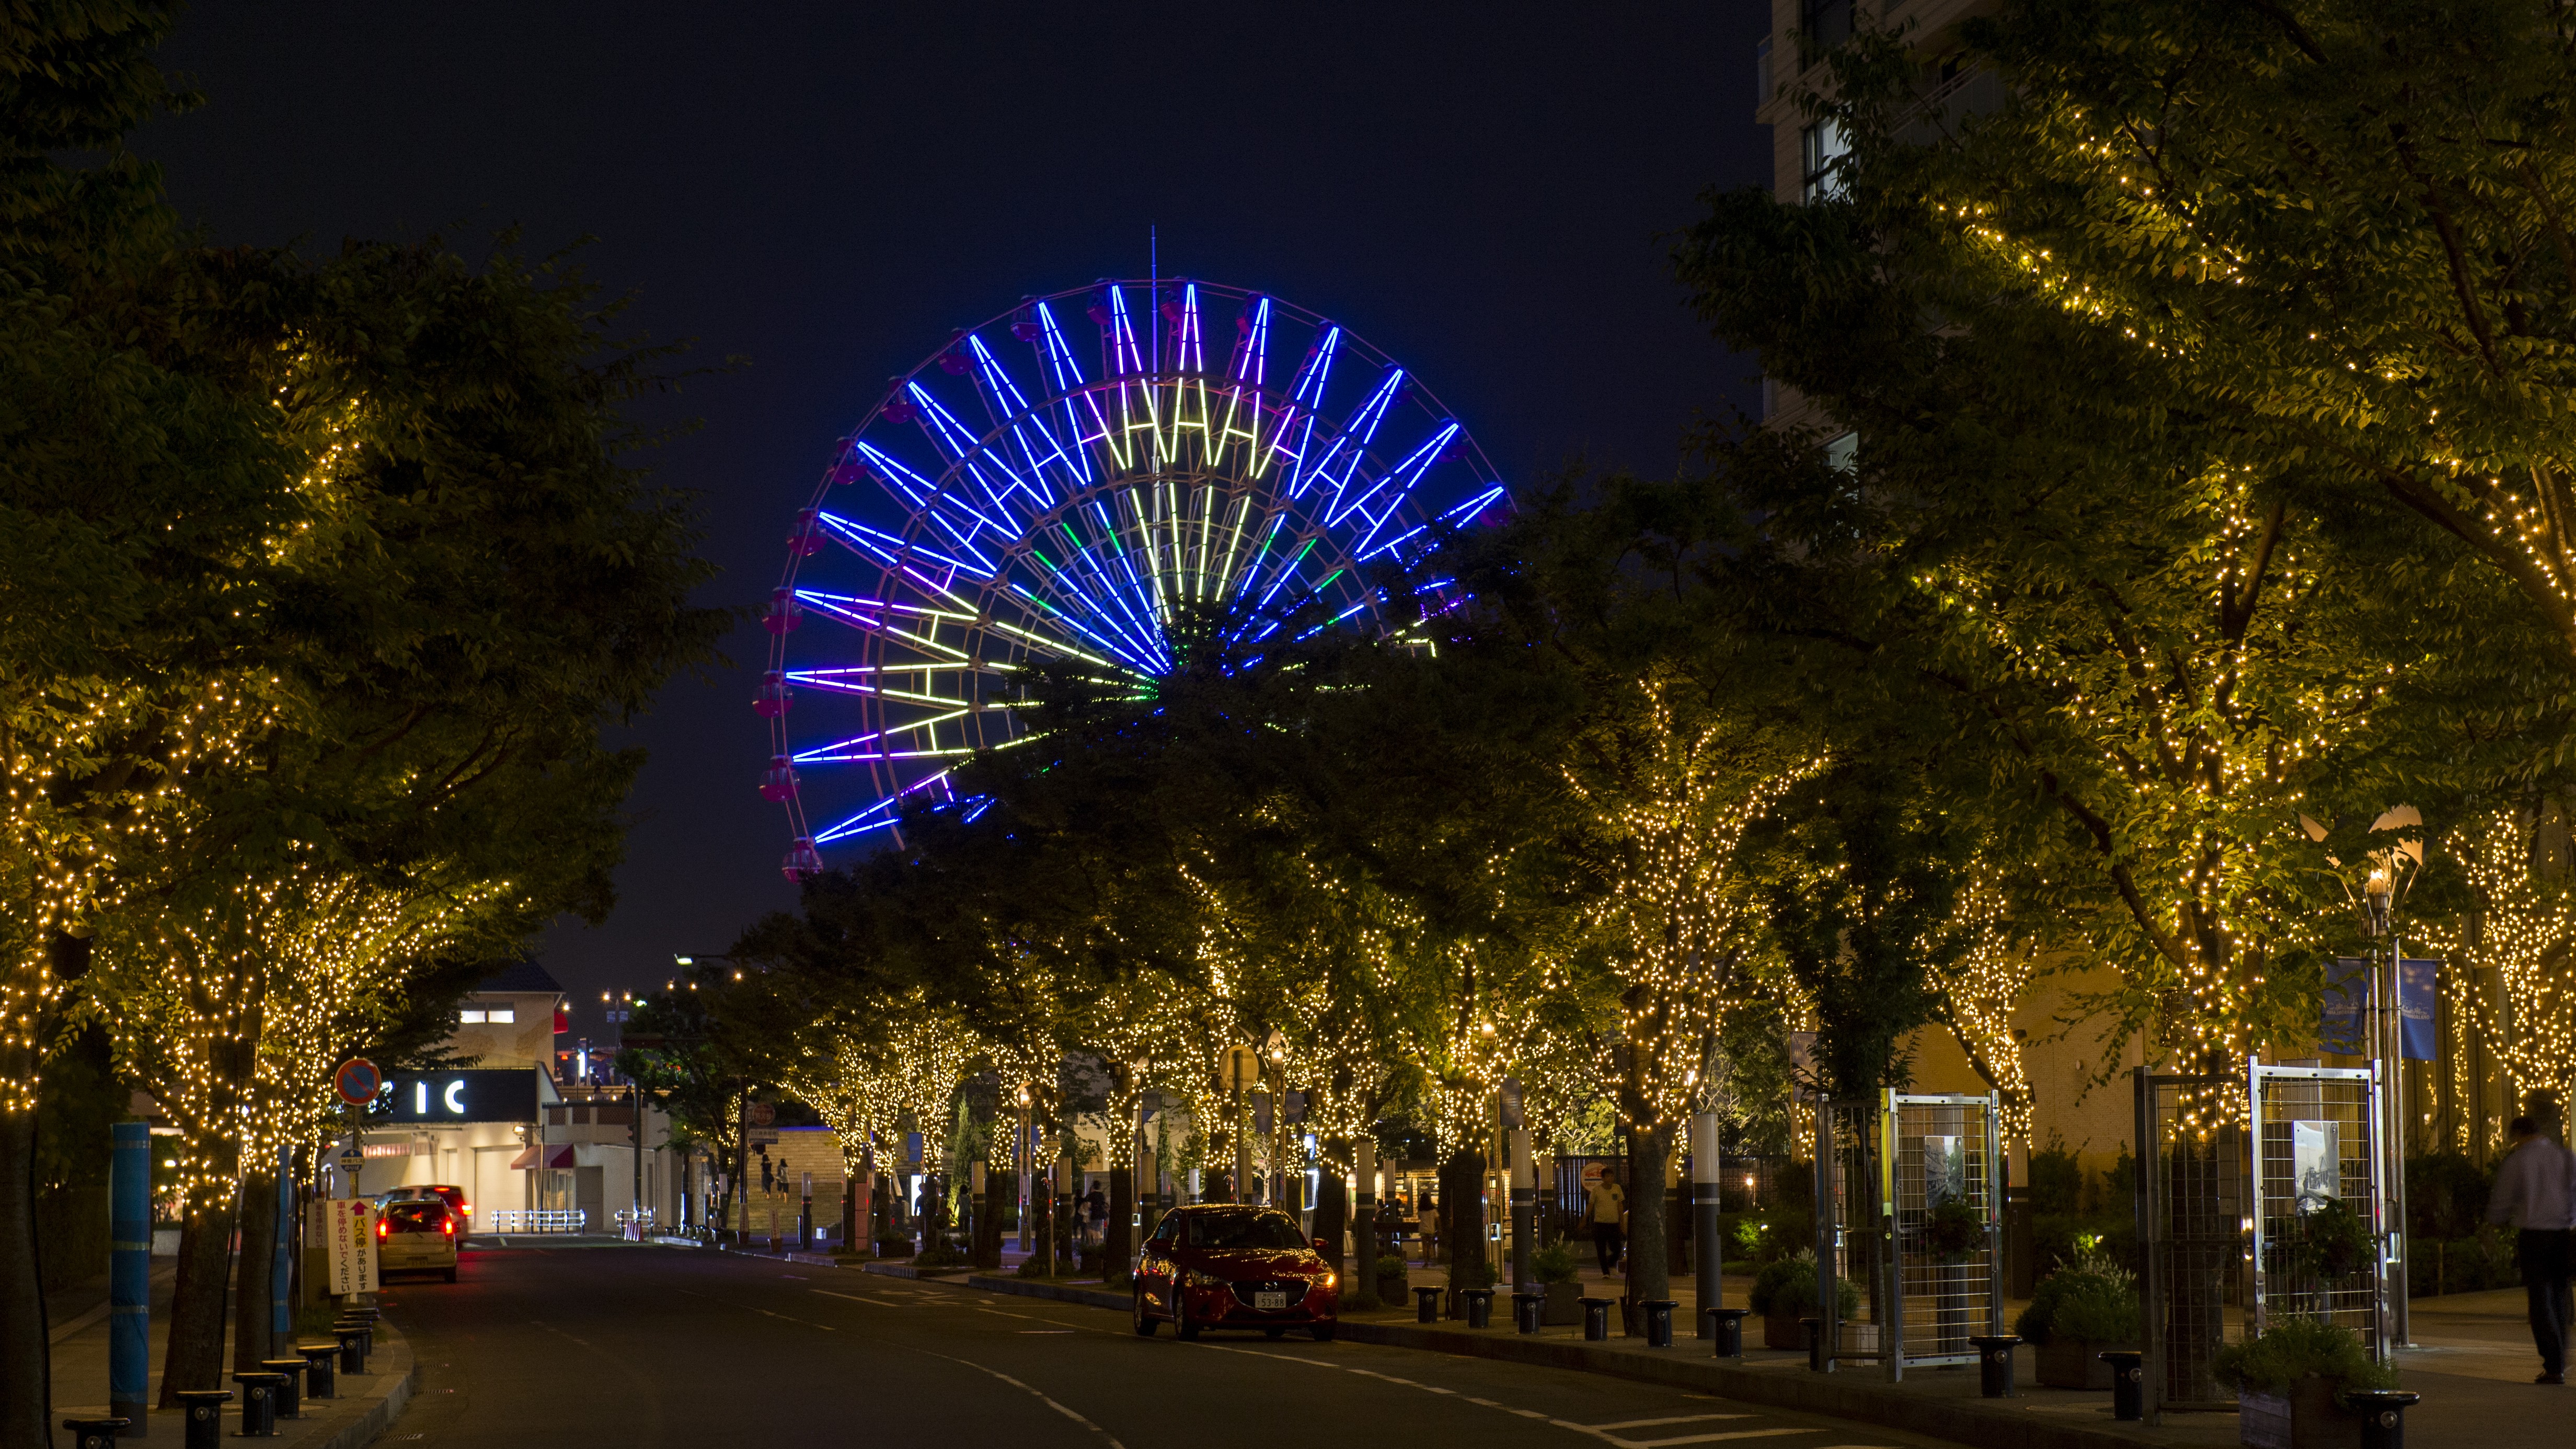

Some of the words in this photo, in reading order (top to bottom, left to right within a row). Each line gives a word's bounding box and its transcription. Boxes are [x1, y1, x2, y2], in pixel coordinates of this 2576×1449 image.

[337, 1201, 350, 1292] 車を停めないでください
[354, 1218, 367, 1290] バス停があります
[1261, 1298, 1284, 1307] 53-88
